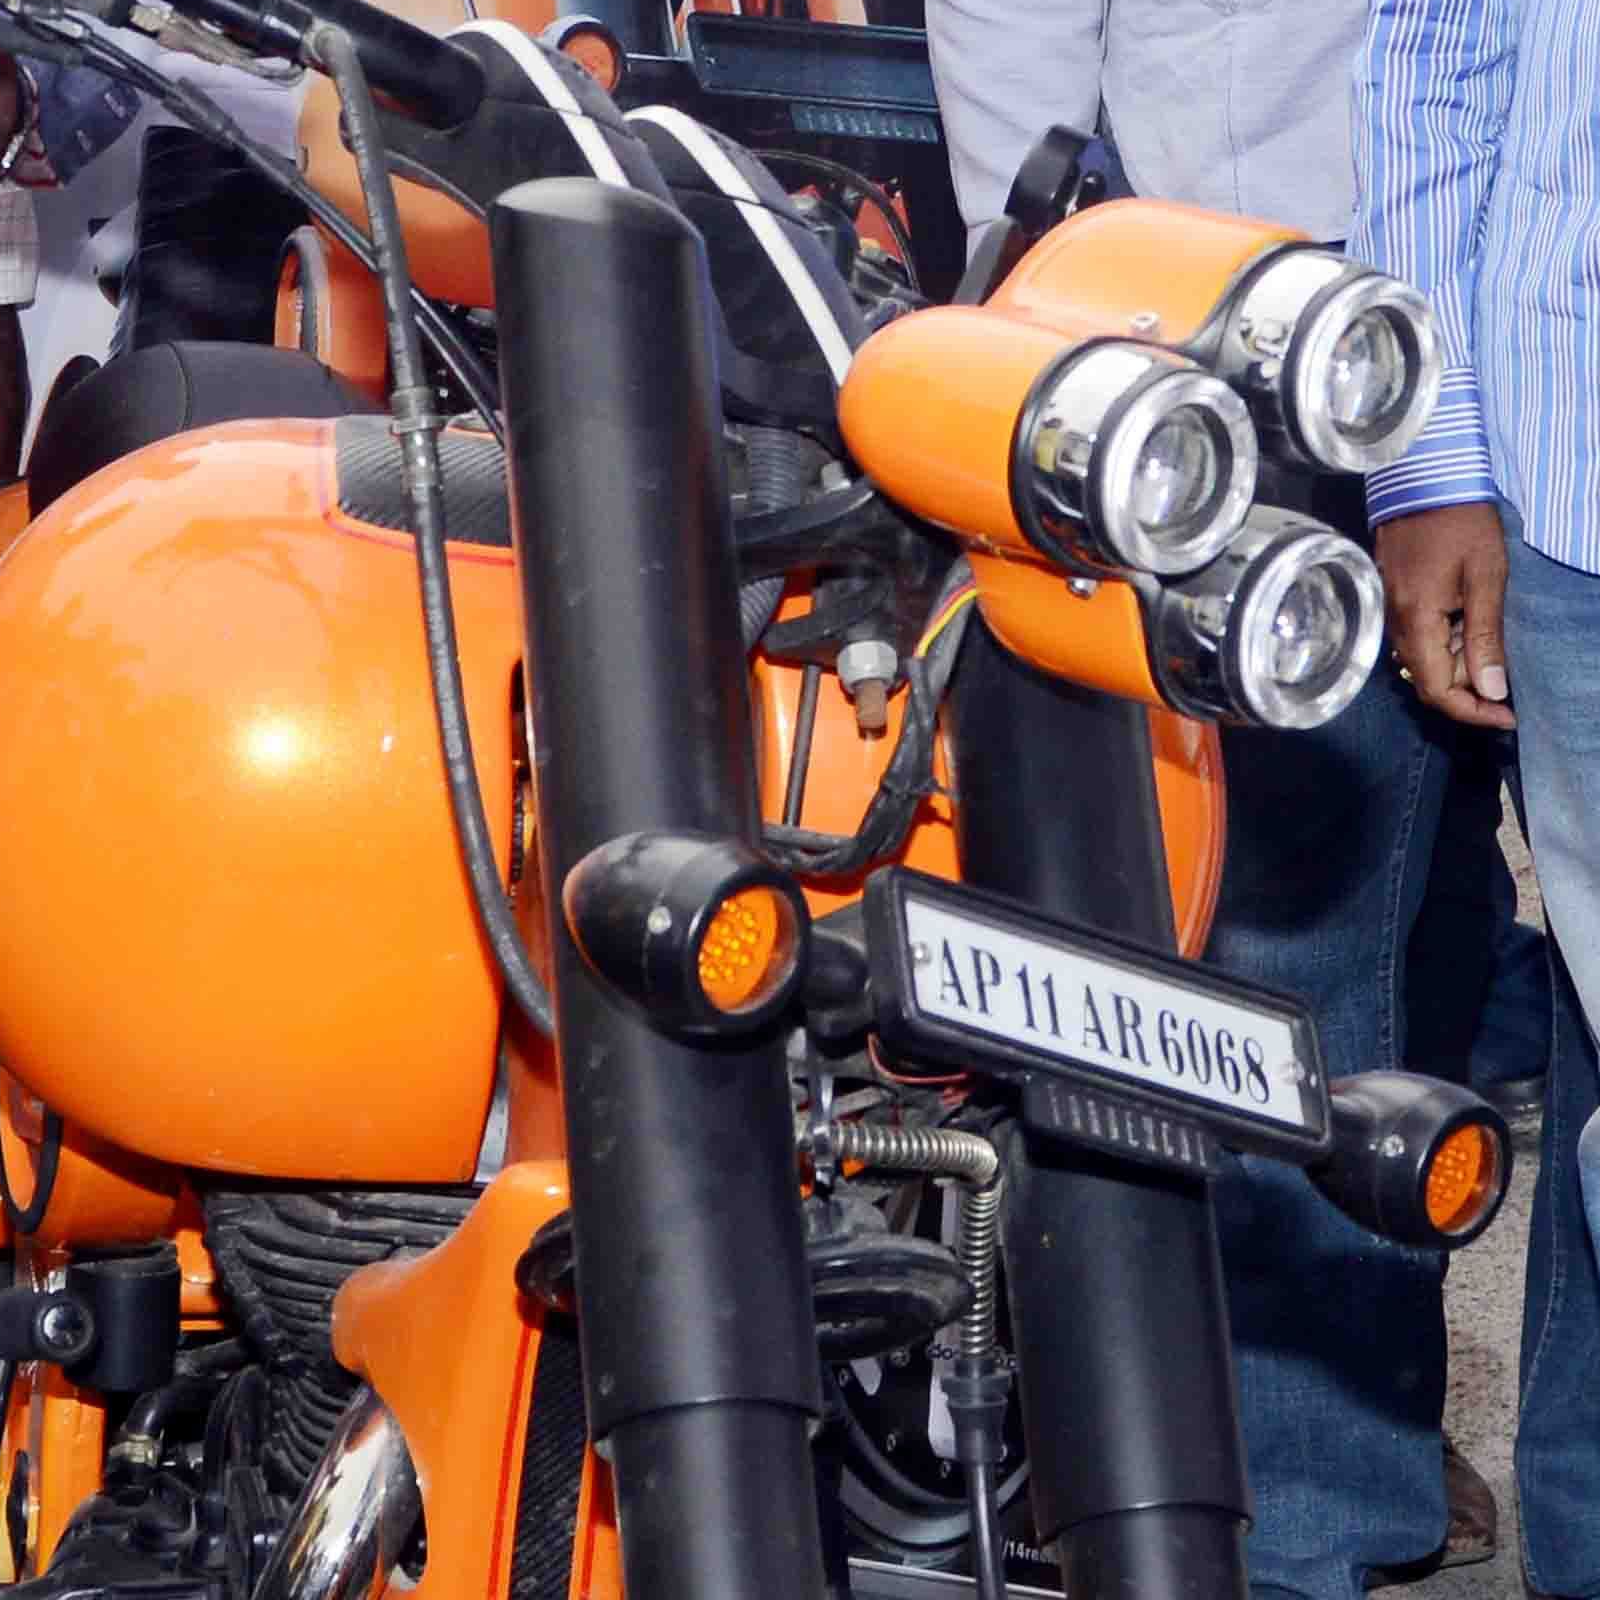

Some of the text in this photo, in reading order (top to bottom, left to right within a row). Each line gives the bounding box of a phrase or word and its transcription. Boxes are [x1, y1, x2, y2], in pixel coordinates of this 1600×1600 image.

[938, 937, 1272, 1105] AP 11 AR 6068
